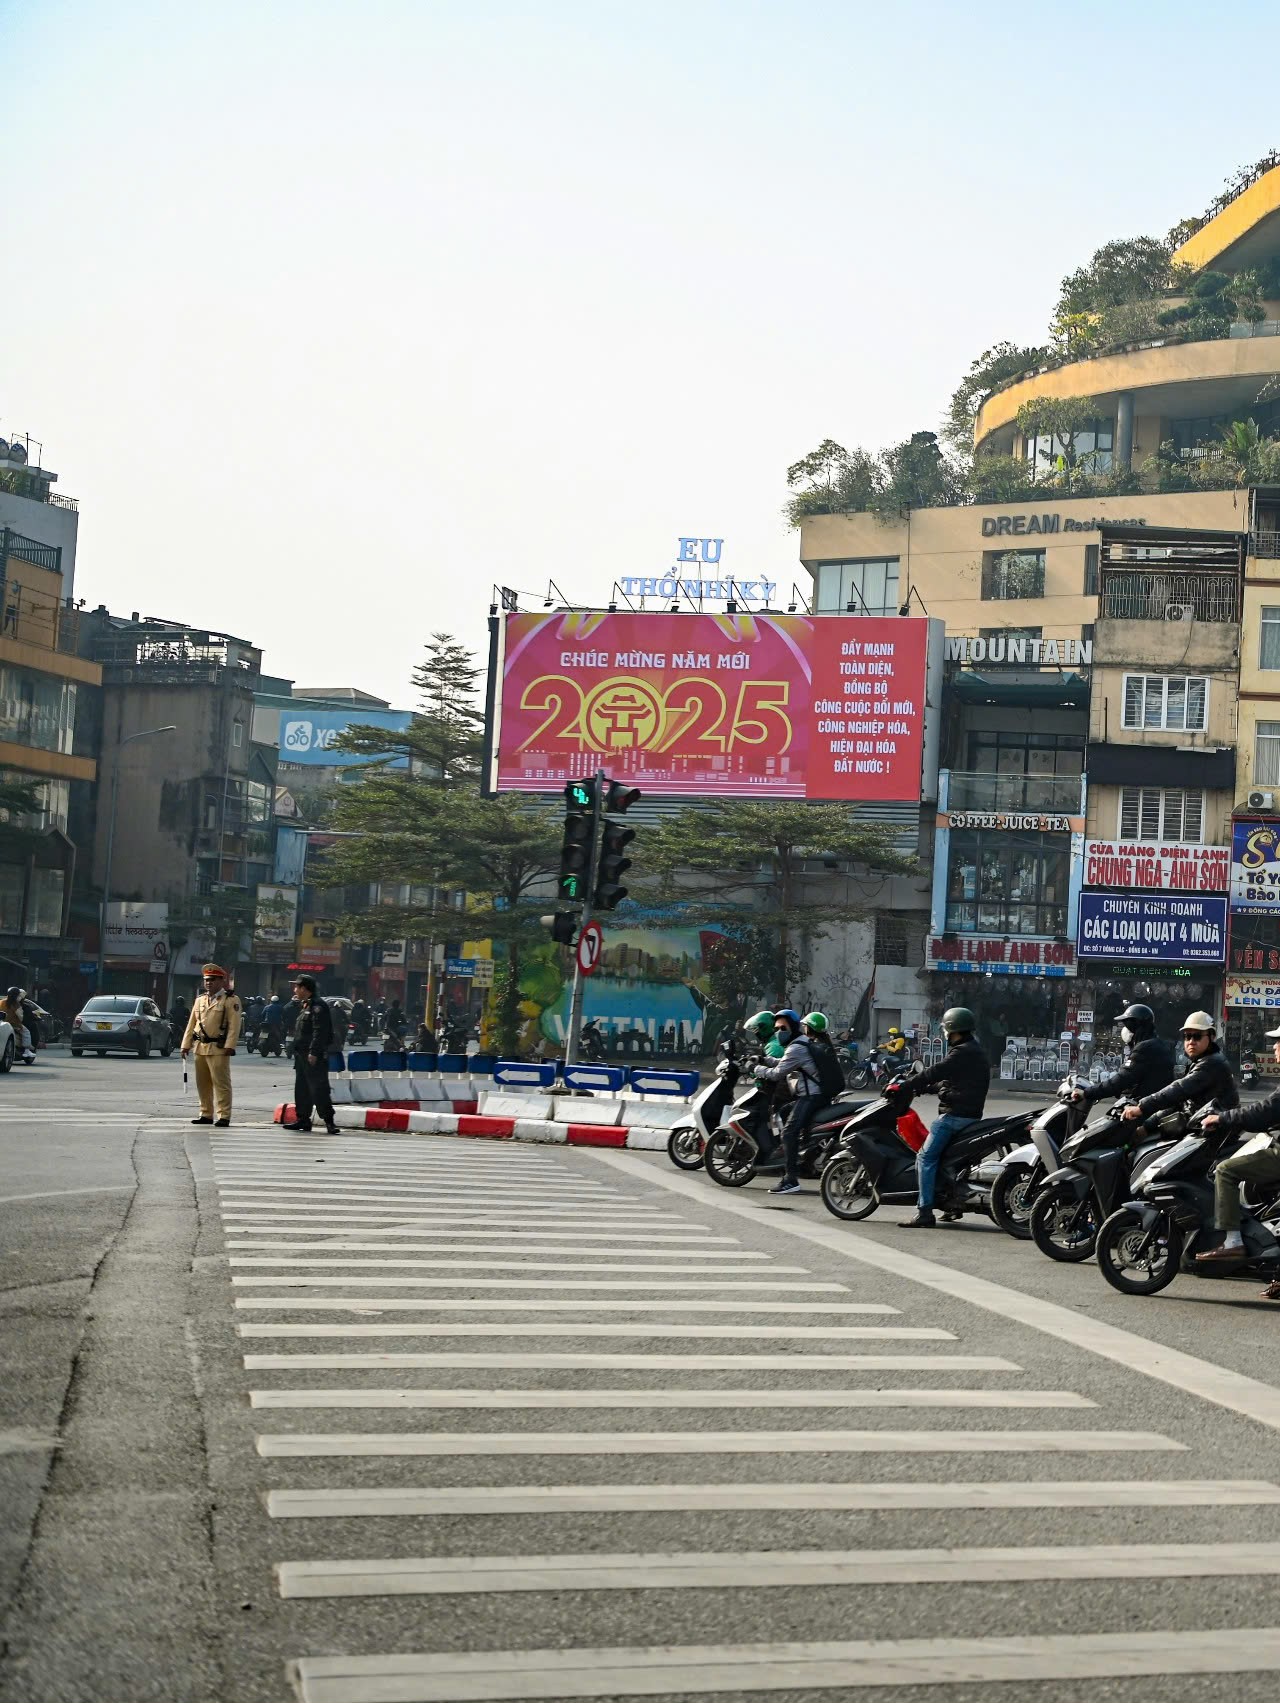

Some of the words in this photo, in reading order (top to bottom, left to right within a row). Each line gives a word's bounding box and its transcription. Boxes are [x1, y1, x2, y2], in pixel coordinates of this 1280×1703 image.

[982, 514, 1059, 537] DREAM
[677, 537, 724, 563] EU
[621, 566, 677, 599] THỔ
[738, 574, 776, 601] KỲ
[841, 638, 861, 656] ĐẨY
[864, 643, 894, 658] MẠNH
[945, 637, 1093, 664] MOUNTAIN
[560, 649, 608, 667] CHÚC
[615, 650, 665, 668] MỪNG
[672, 650, 711, 669] NĂM
[717, 651, 750, 670] MỚI
[840, 660, 865, 675] TOÀN
[868, 660, 895, 677] DIỆN,
[844, 678, 871, 695] ĐỒNG
[874, 680, 888, 697] BỘ
[516, 674, 793, 755] 2025
[814, 699, 841, 714] CÔNG
[844, 700, 870, 717] CUỘC
[873, 696, 890, 715] ĐỔI
[893, 699, 916, 717] MỚI,
[817, 718, 845, 734] CÔNG
[847, 719, 884, 736] NGHIỆP
[887, 719, 911, 736] HÓA,
[830, 738, 853, 756] HIỆN
[856, 741, 873, 756] ĐẠI
[876, 739, 896, 754] HÓA
[834, 755, 853, 773] ĐẤT
[855, 759, 883, 773] NƯỚC
[948, 814, 997, 828] COFFEE
[1002, 816, 1039, 829] JUICE
[1046, 817, 1071, 831] TEA
[1089, 841, 1114, 856] CỬA
[1119, 843, 1156, 858] HÀNG
[1160, 844, 1189, 861] ĐIỆN
[1087, 857, 1132, 886] CHUNG
[1134, 860, 1163, 887] NGA
[1200, 862, 1229, 891] SƠN
[1246, 868, 1267, 886] Tổ
[1246, 887, 1276, 901] Bào
[1103, 899, 1140, 914] CHUYÊN
[1171, 902, 1203, 917] DOANH
[1084, 915, 1110, 940] CÁC
[1112, 920, 1140, 944] LOẠI
[1144, 921, 1177, 946] QUẠT
[1179, 922, 1188, 942] 4
[1191, 919, 1220, 943] MÙA
[1234, 942, 1264, 970] YẾN
[1240, 986, 1260, 995] ƯU
[1234, 997, 1261, 1006] LÊN
